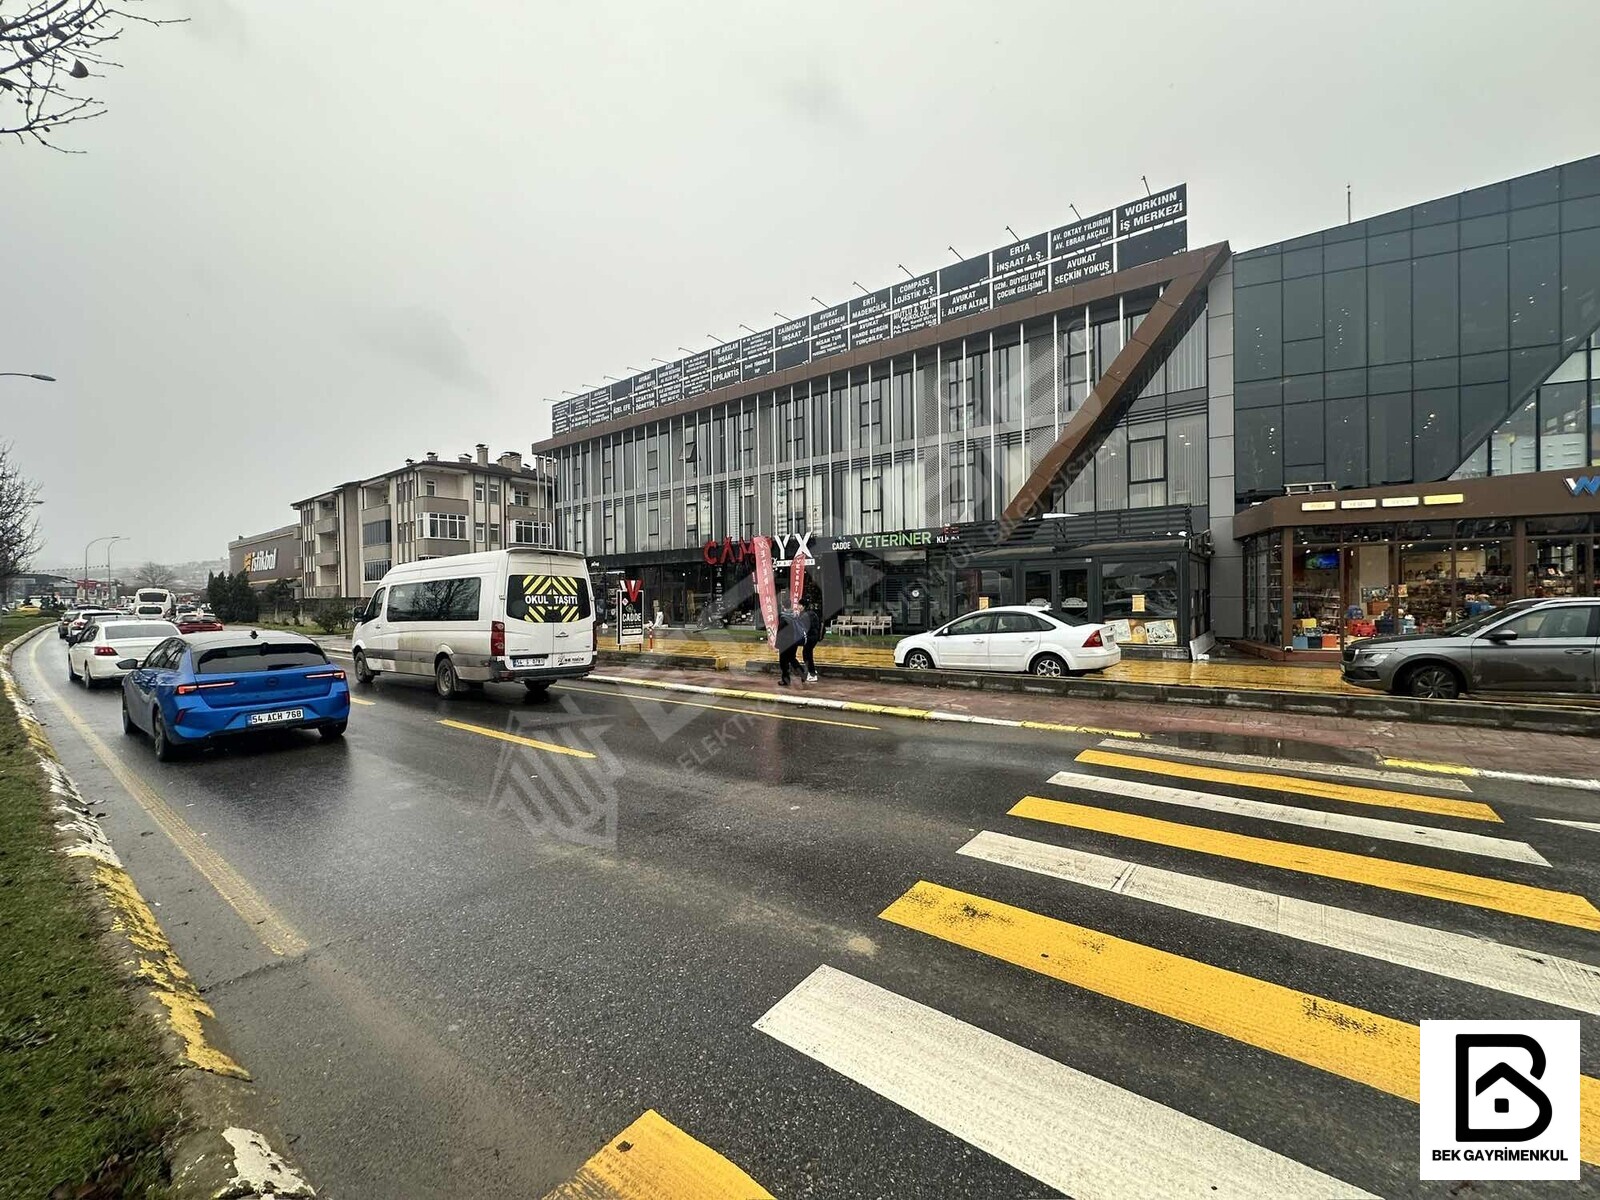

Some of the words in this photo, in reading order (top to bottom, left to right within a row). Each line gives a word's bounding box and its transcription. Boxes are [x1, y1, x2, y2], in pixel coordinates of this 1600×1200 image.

[1125, 191, 1177, 217] WORKINN
[1120, 219, 1131, 232] İŞ
[1133, 199, 1183, 227] MERKEZİ
[1053, 233, 1061, 243] AV.
[1063, 227, 1082, 239] OKTAY
[1083, 216, 1111, 233] YILDIRIM
[1055, 240, 1064, 250] AV.
[1066, 235, 1085, 248] EBRAR
[1087, 226, 1109, 242] AKÇALI
[1009, 242, 1030, 257] ERTA
[996, 255, 1025, 273] İNŞAAT
[1067, 252, 1097, 270] AVUKAT
[994, 280, 1007, 291] UZM.
[1009, 275, 1028, 287] DUYGU
[1029, 268, 1046, 281] UYAR
[1054, 267, 1082, 286] SEÇKİN
[1084, 260, 1110, 277] YOKUŞ
[900, 277, 930, 293] COMPASS
[996, 287, 1016, 301] ÇOCUK
[894, 290, 921, 306] LOJİSTİK
[948, 304, 967, 316] ALPER
[969, 297, 988, 309] ALTAN
[952, 290, 976, 305] AVUKAT
[820, 309, 839, 321] AVUKAT
[859, 319, 879, 330] AVUKAT
[854, 531, 932, 549] VETERİNER
[525, 595, 549, 605] OKUL
[554, 594, 578, 606] TAŞITI
[267, 713, 283, 721] ACH
